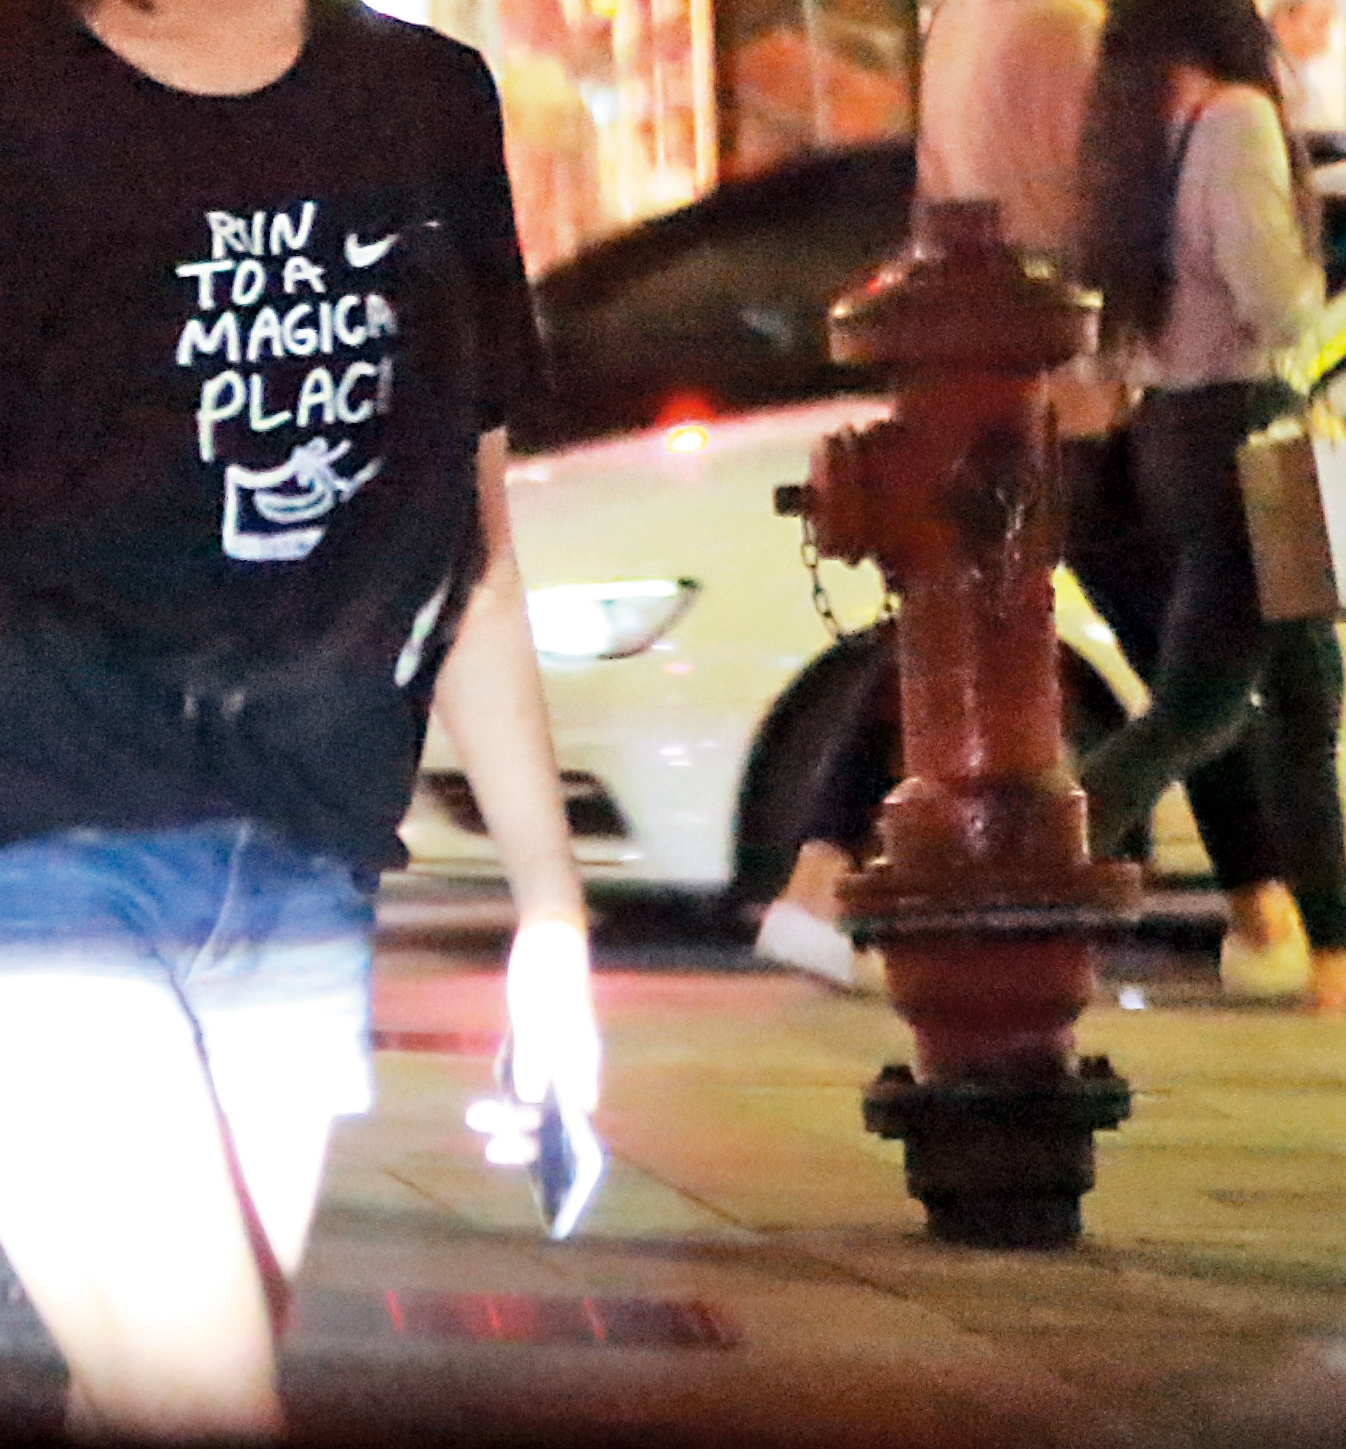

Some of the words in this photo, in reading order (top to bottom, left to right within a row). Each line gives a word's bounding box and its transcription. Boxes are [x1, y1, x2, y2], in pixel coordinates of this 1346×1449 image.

[206, 201, 317, 259] RUN
[175, 258, 265, 310] TO
[283, 255, 327, 294] A
